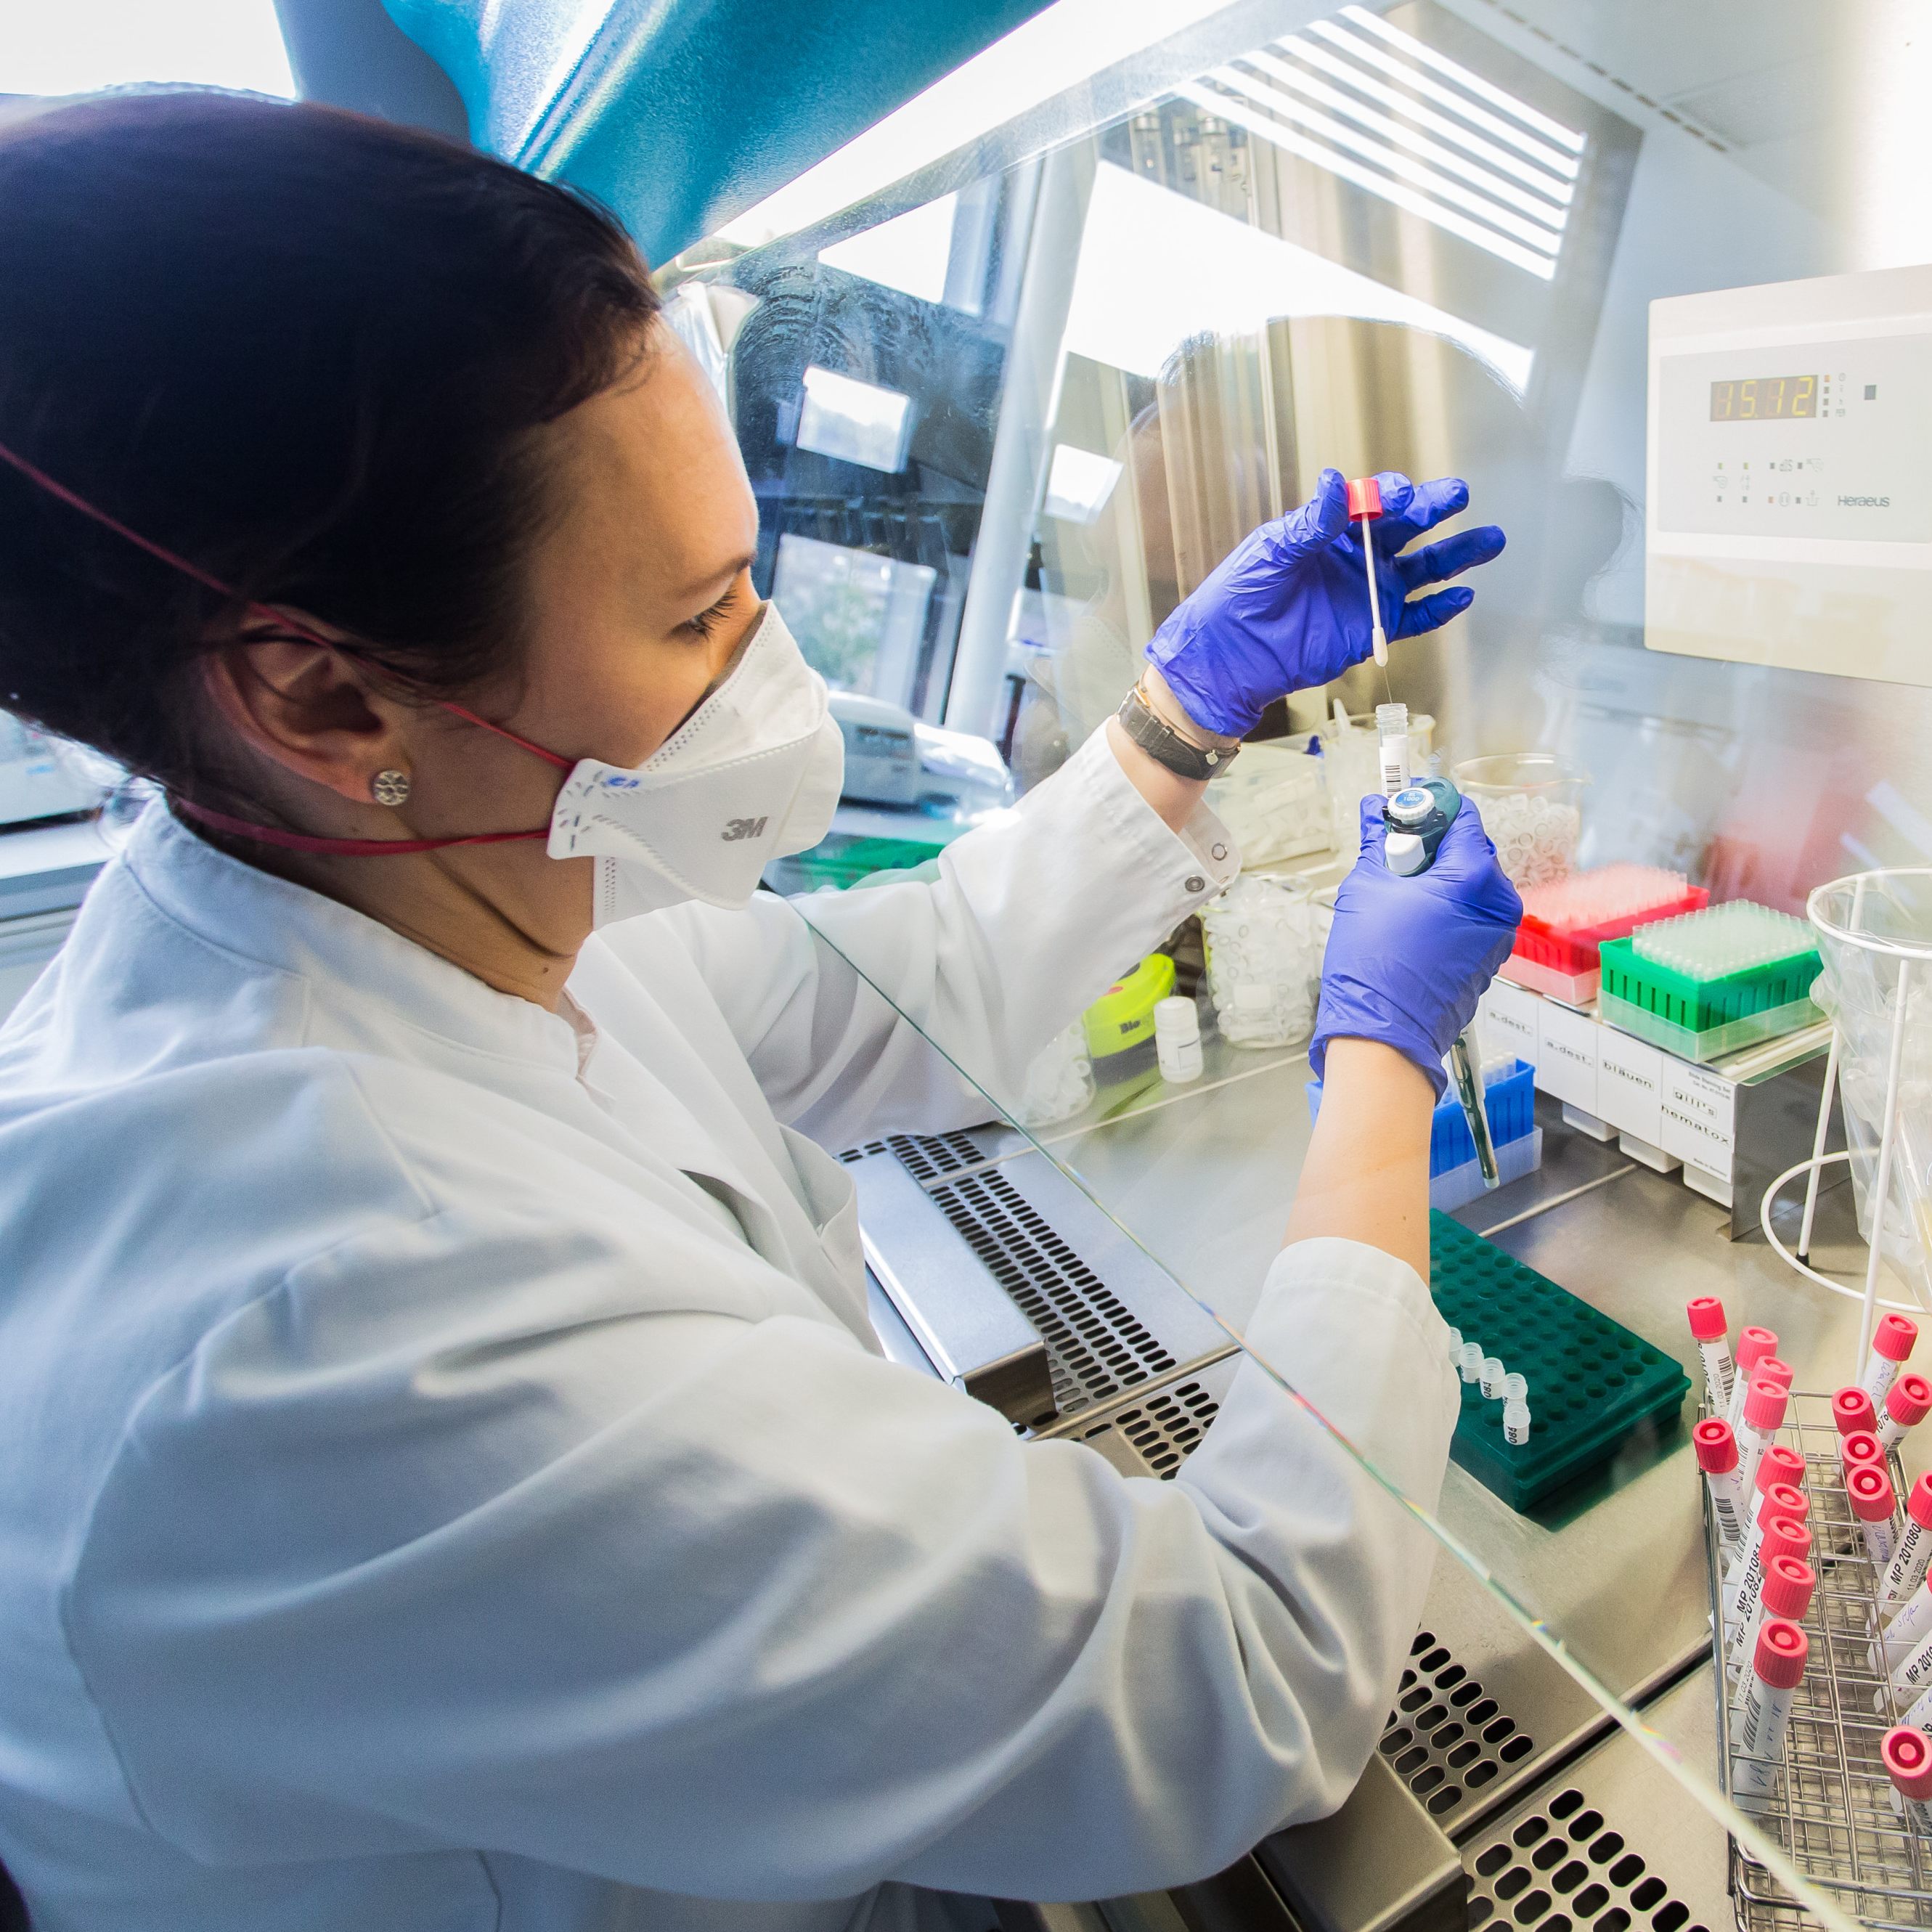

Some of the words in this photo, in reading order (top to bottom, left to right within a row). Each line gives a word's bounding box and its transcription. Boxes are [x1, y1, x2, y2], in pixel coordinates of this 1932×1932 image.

[1838, 494, 1891, 508] Heraeus
[721, 816, 769, 841] 3M
[1489, 1011, 1531, 1035] a.dest.
[1546, 1040, 1592, 1066] a.dest.
[1674, 1091, 1715, 1117] gill's
[1661, 1104, 1729, 1145] hematox
[1890, 1562, 1904, 1586] MP
[1898, 1523, 1922, 1566] 201080
[1736, 1590, 1748, 1613] MP
[1736, 1622, 1745, 1648] MP
[1905, 1663, 1920, 1685] MP
